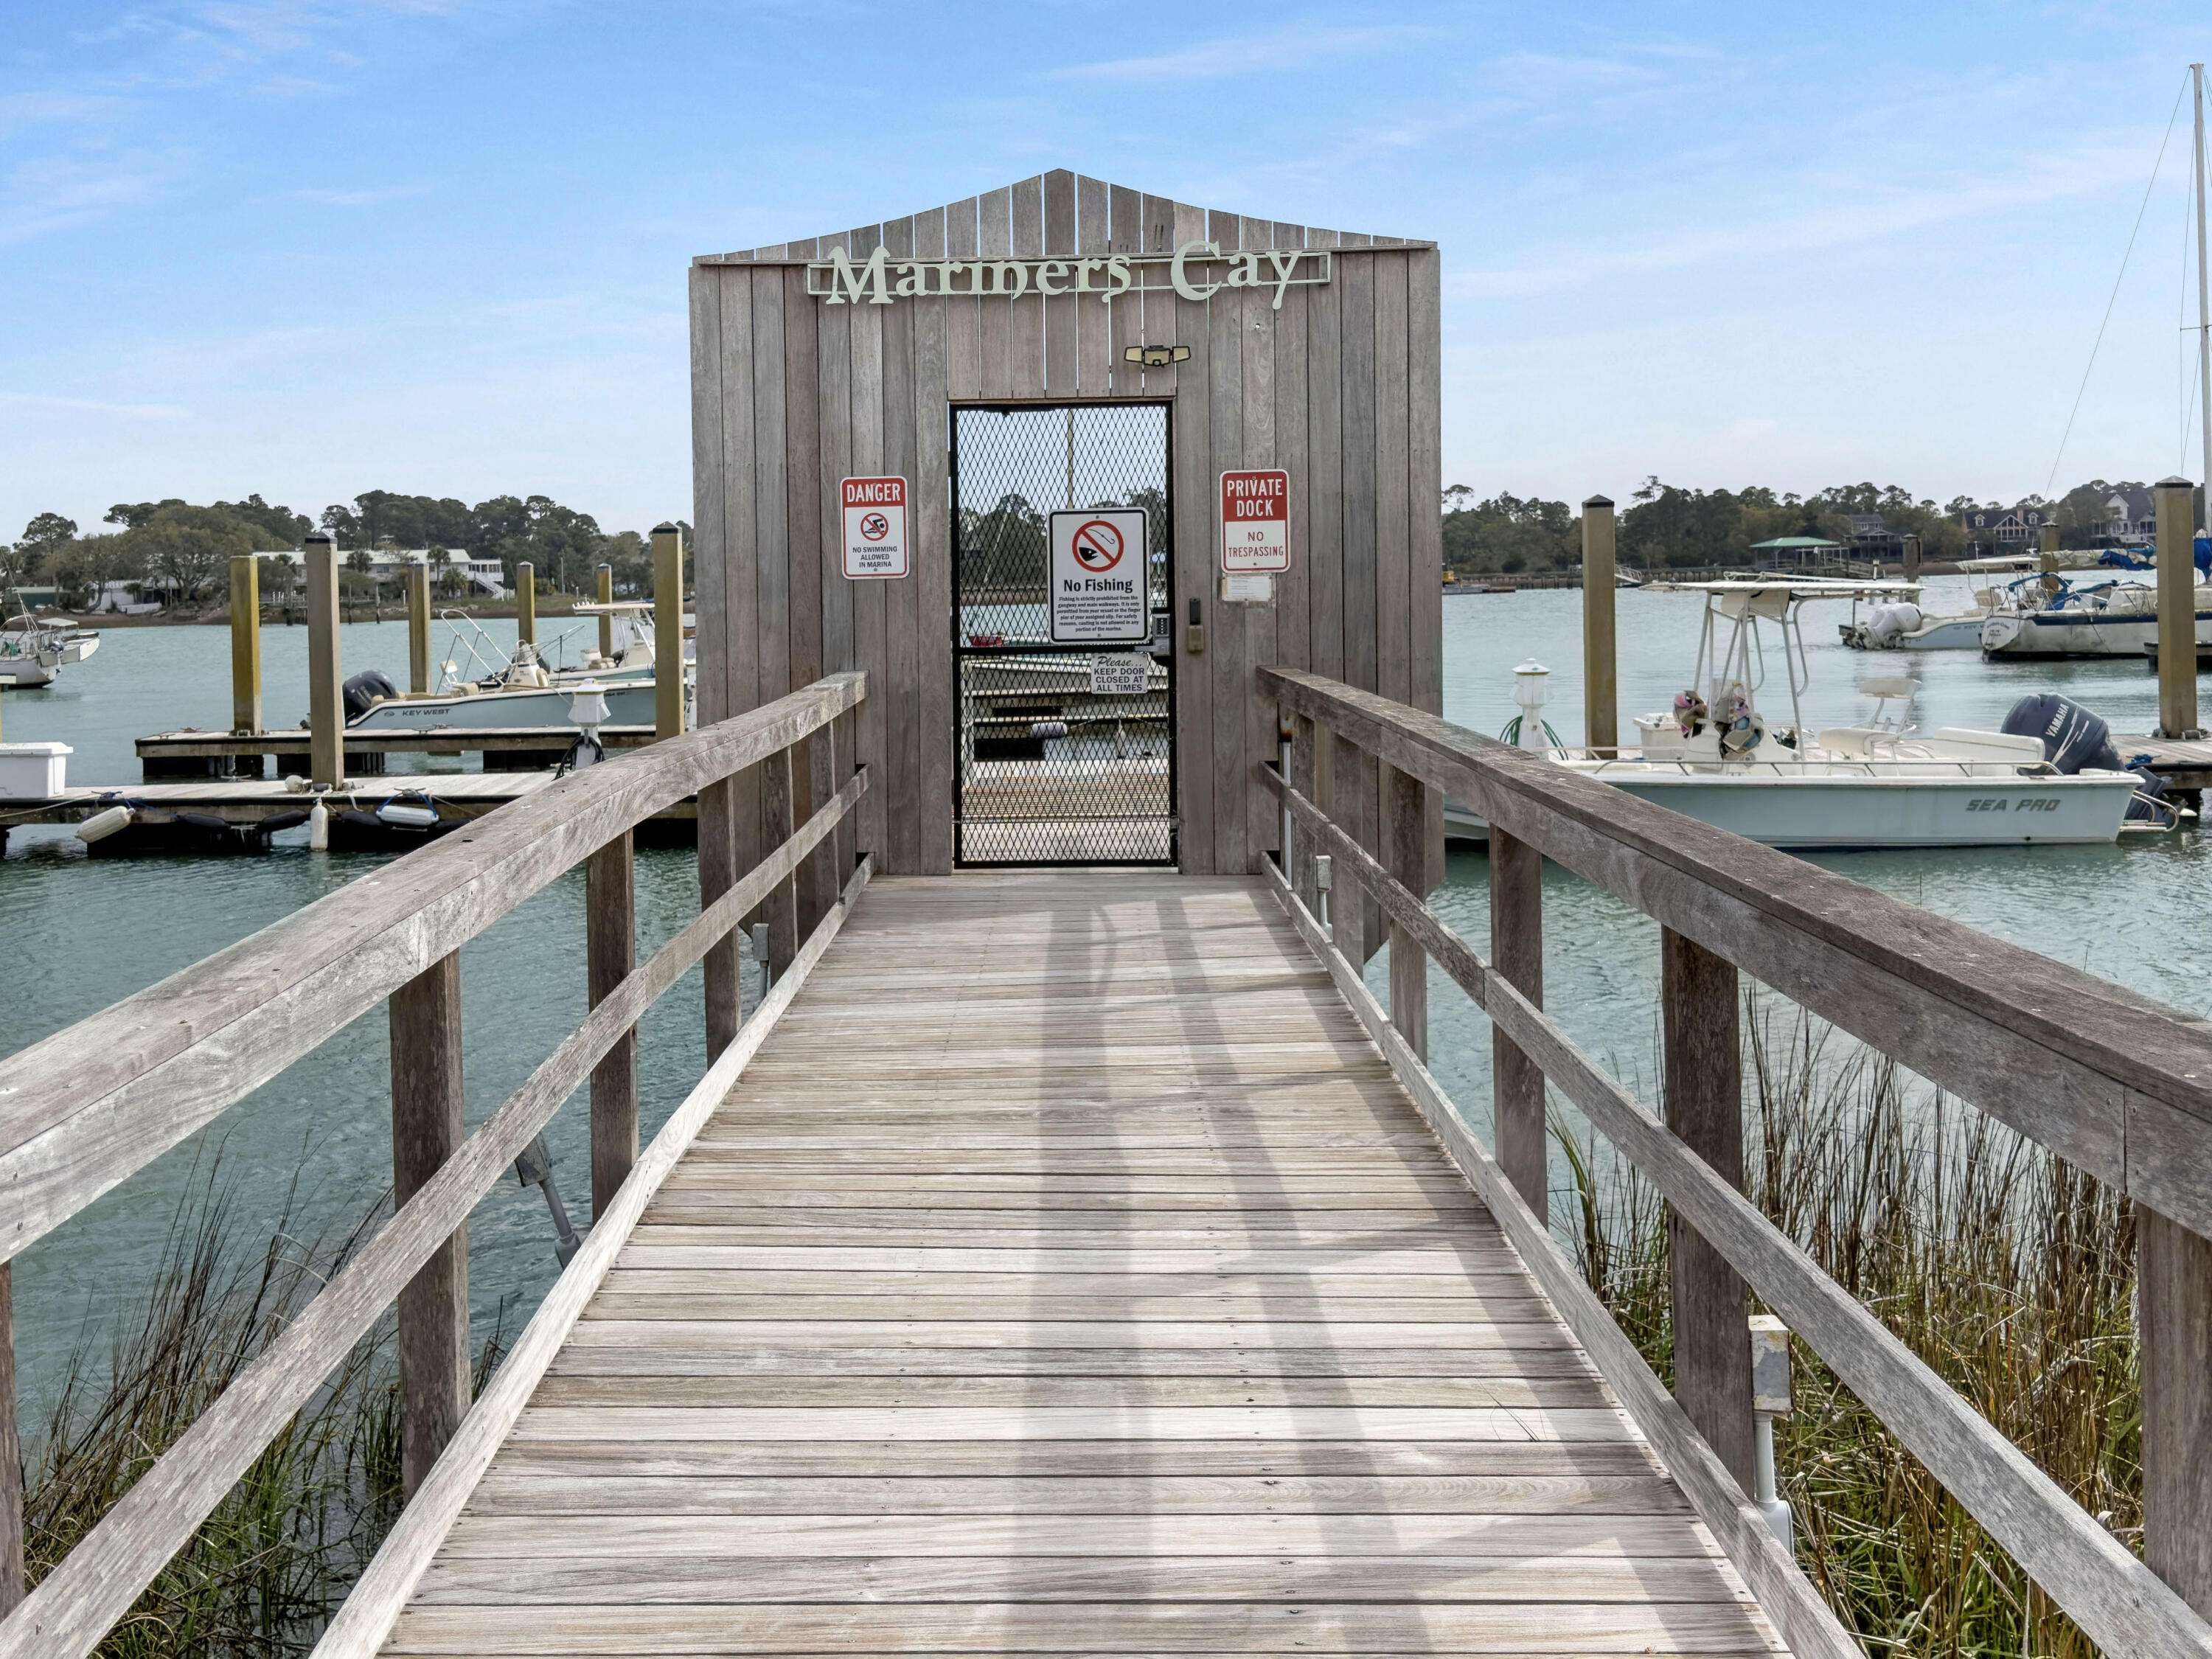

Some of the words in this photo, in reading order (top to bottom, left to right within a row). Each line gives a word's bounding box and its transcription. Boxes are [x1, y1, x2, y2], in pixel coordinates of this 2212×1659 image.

[825, 246, 1131, 304] Mariners
[1171, 240, 1302, 310] Cay
[847, 484, 900, 502] DANGER
[1227, 479, 1283, 497] PRIVATE
[1237, 500, 1273, 517] DOCK
[1248, 532, 1264, 542] NO
[1228, 546, 1284, 557] TRESPASSING
[1064, 580, 1081, 591] No
[1085, 579, 1133, 594] Fishing
[2045, 703, 2069, 737] YAMAHA
[1966, 799, 2007, 811] SEA
[2015, 799, 2062, 811] PRO
